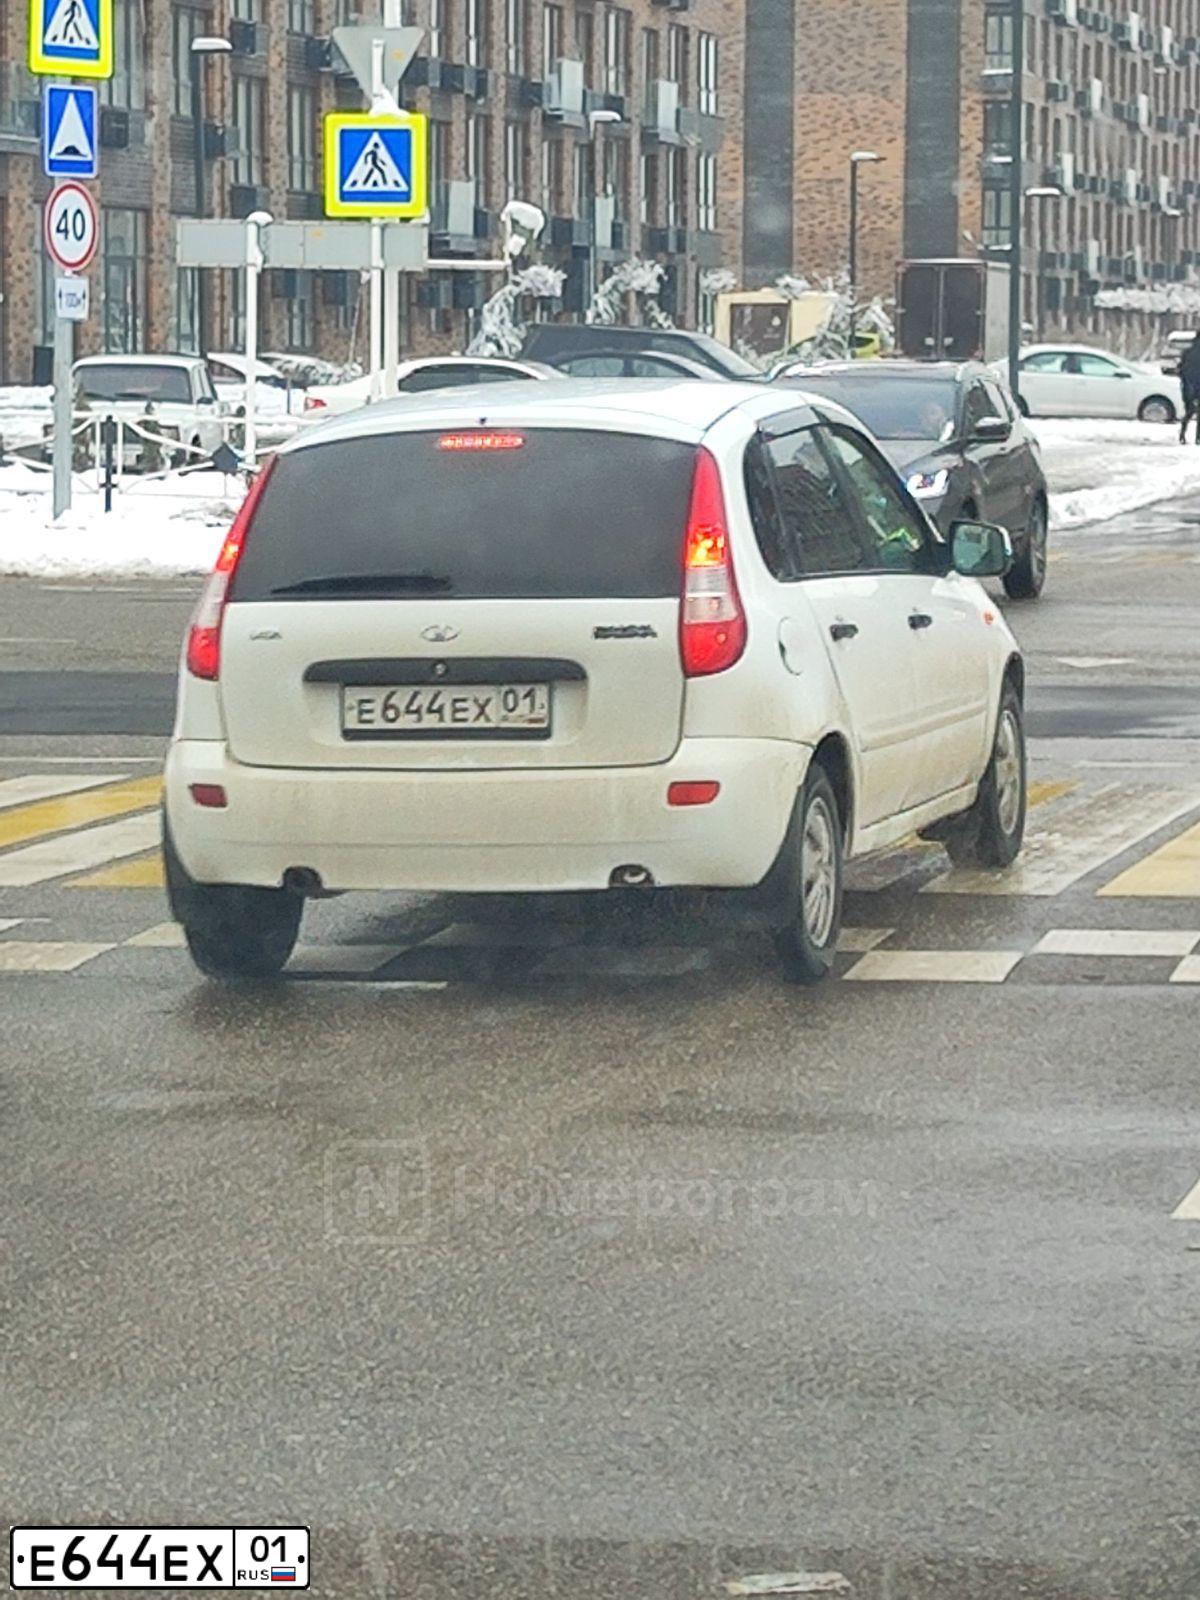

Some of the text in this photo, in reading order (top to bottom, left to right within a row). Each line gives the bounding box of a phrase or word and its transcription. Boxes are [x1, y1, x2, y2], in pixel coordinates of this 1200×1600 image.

[56, 208, 86, 241] 40
[357, 688, 536, 723] Е644ЕХ 01
